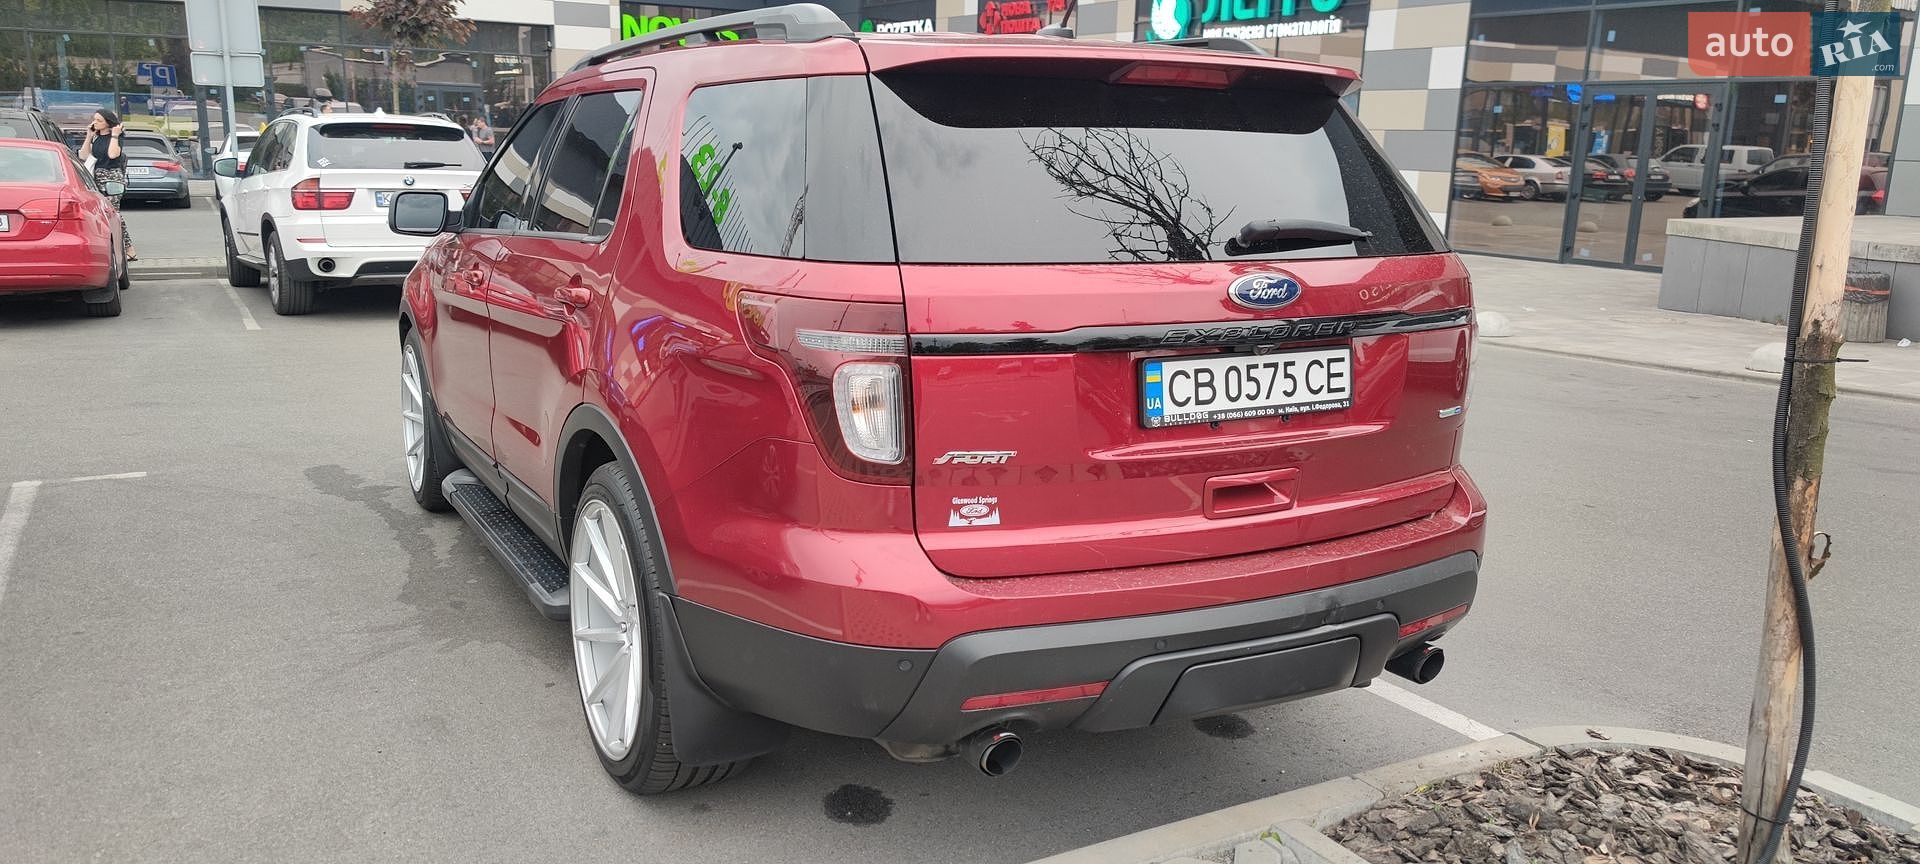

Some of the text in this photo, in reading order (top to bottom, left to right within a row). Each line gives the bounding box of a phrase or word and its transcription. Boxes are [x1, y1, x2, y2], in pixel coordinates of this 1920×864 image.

[1001, 1, 1031, 16] НОВА
[1001, 17, 1041, 34] ПОШТА
[1266, 14, 1341, 38] стоматологія
[1250, 276, 1288, 300] Ford
[1161, 319, 1357, 345] EXPLORER
[1168, 356, 1346, 407] CB 0575 CE
[1146, 397, 1162, 410] UA
[1213, 412, 1225, 420] +38
[1226, 410, 1243, 420] (066)
[1244, 409, 1256, 418] 609
[932, 451, 1017, 465] SPORT
[952, 495, 998, 505] Glenwood Springs
